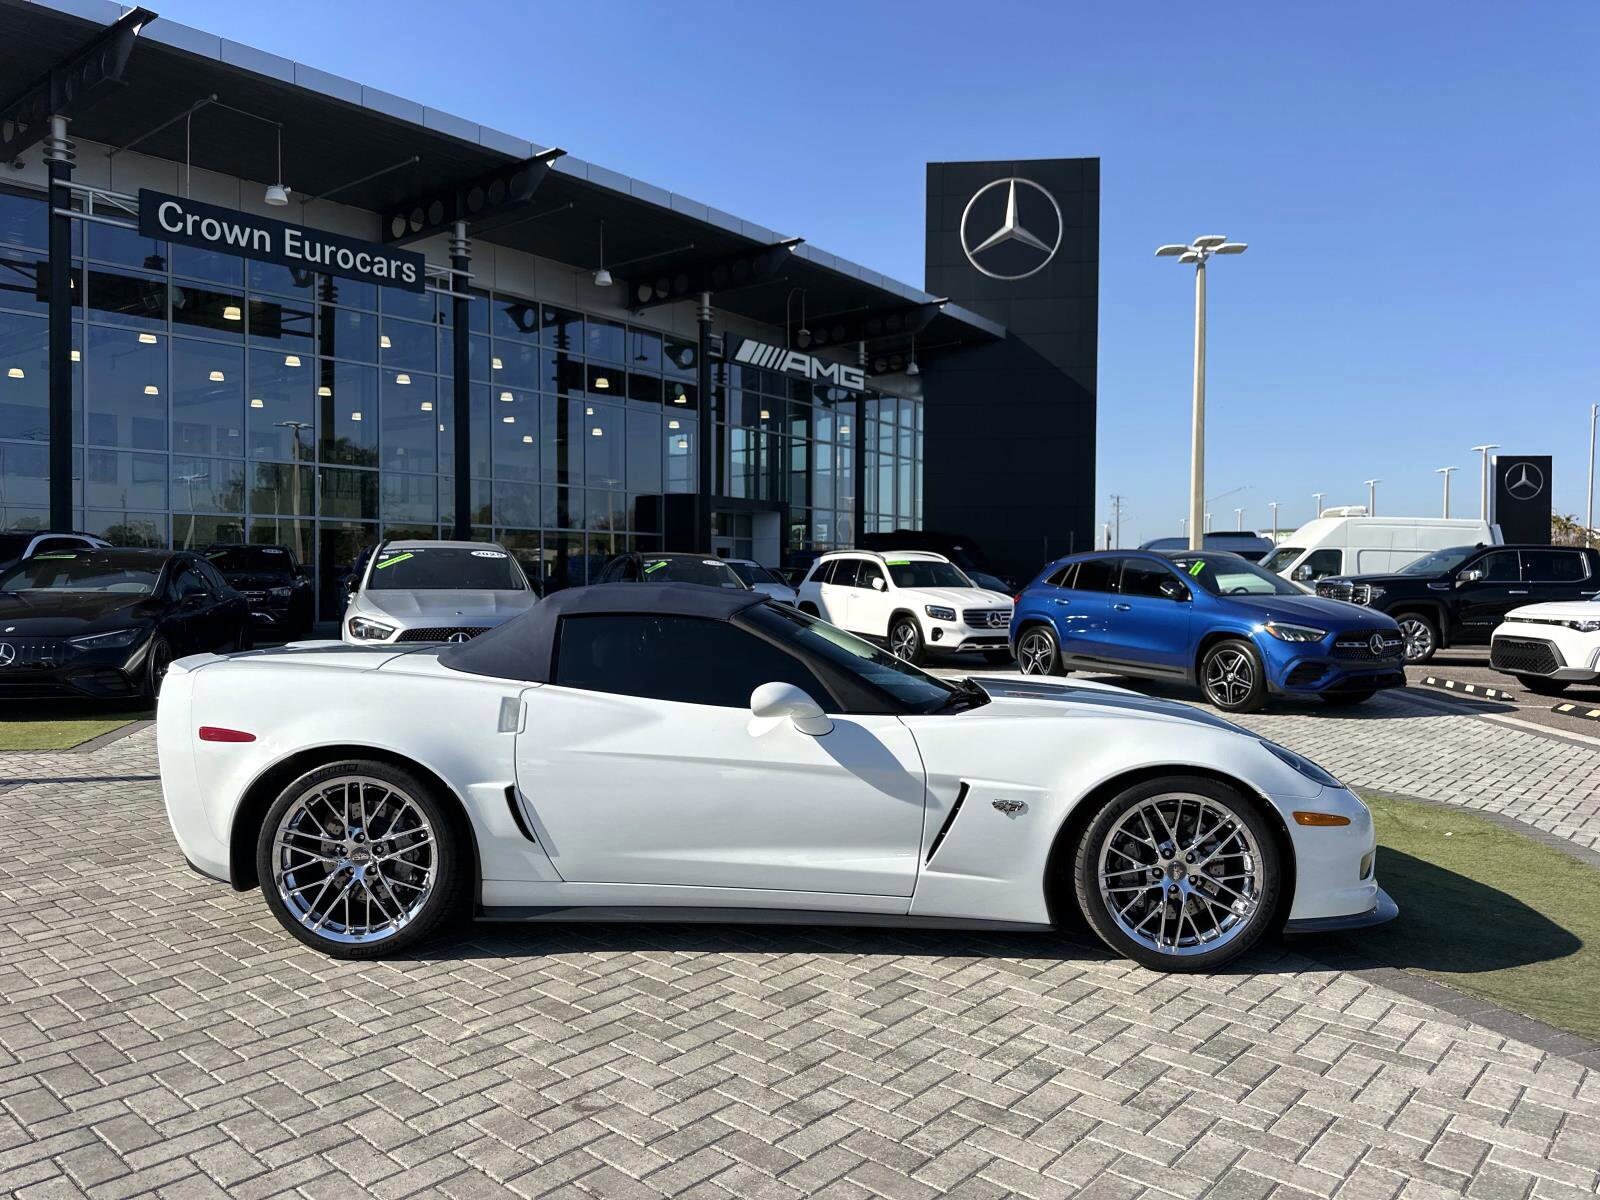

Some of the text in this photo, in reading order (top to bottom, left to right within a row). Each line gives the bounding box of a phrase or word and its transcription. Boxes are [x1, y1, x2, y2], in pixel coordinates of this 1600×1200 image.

[157, 201, 417, 284] Crown Eurocars
[780, 351, 865, 392] AMG
